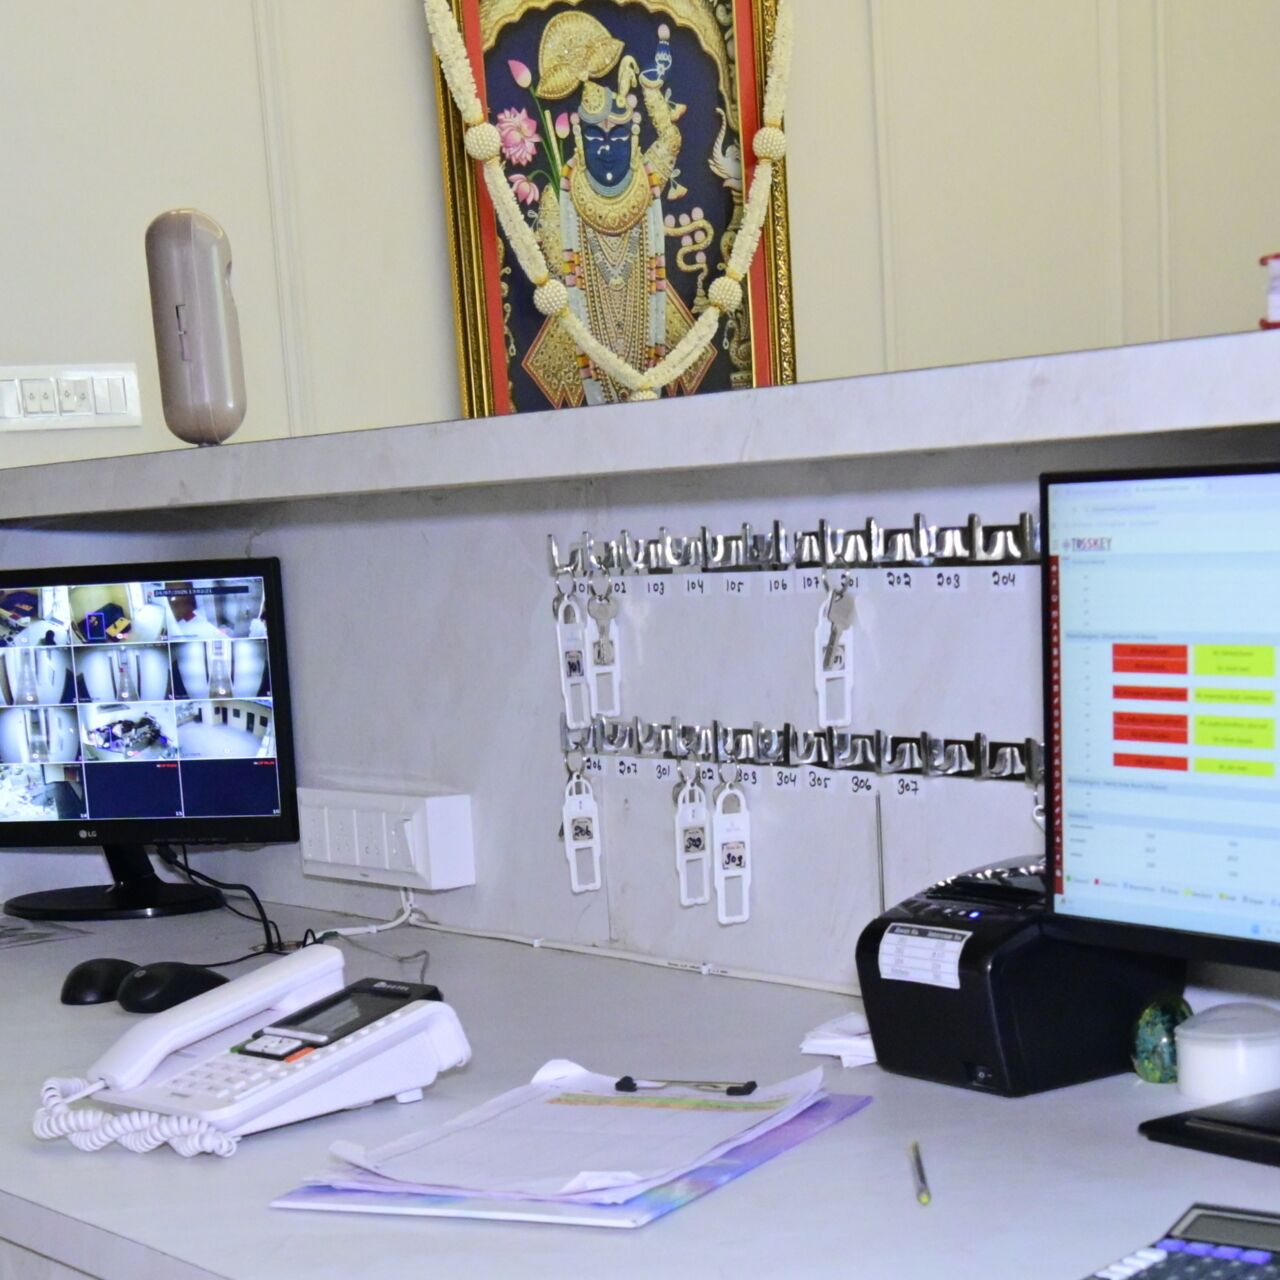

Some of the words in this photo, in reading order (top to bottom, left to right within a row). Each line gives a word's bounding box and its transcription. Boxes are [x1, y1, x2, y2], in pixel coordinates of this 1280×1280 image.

[726, 579, 744, 592] 105
[769, 579, 787, 591] 106
[803, 576, 819, 589] 107
[887, 572, 911, 587] 202
[937, 573, 960, 588] 203
[992, 571, 1015, 586] 204
[647, 582, 665, 595] 103
[687, 580, 704, 593] 104
[619, 761, 638, 775] 207
[656, 765, 670, 779] 301
[776, 771, 797, 786] 304
[808, 771, 831, 789] 305
[851, 776, 872, 793] 306
[897, 778, 920, 795] 307
